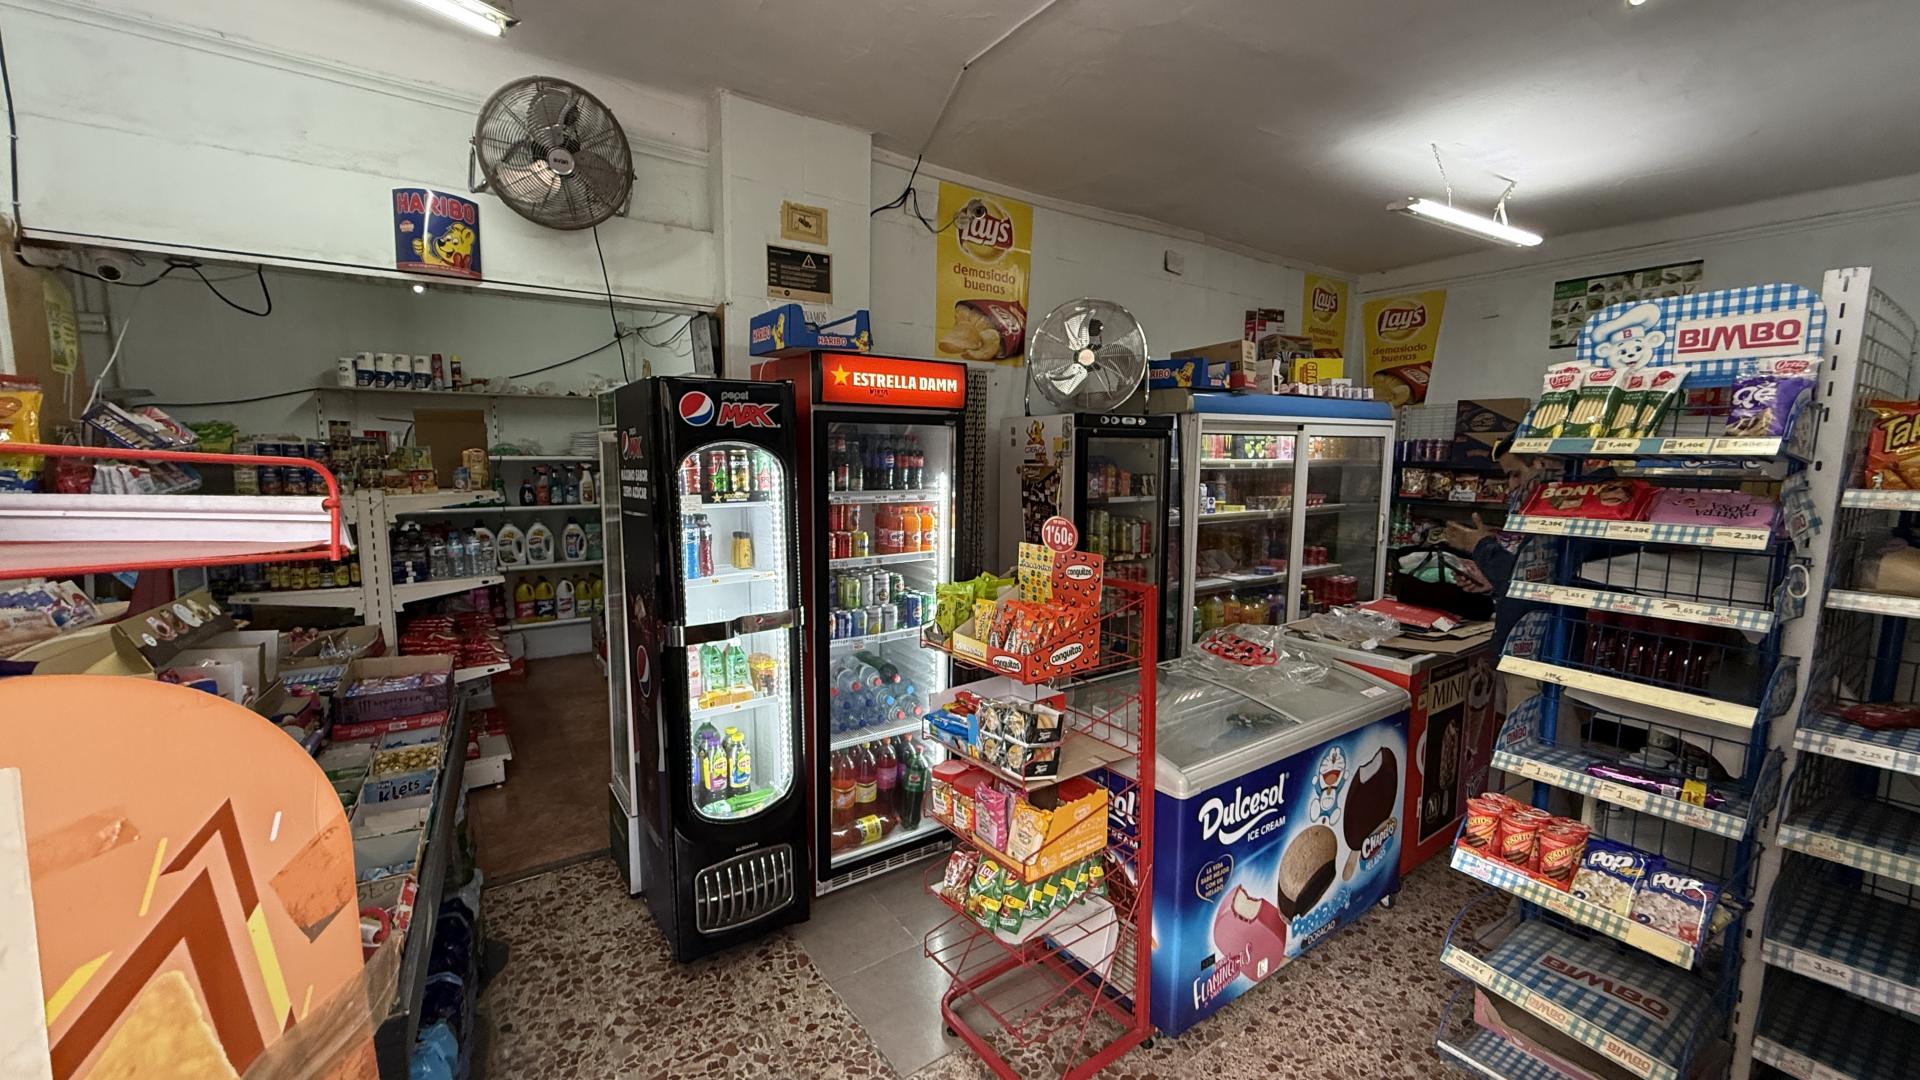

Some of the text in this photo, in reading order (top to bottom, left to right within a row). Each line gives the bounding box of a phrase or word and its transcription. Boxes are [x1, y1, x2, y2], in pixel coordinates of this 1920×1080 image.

[396, 191, 476, 226] HARIBO
[953, 262, 1016, 285] demasiado
[964, 278, 1006, 295] buenas
[1378, 302, 1424, 334] Lay's
[817, 335, 848, 347] HARIBO
[1677, 319, 1802, 352] BIMBO
[1371, 343, 1428, 356] demasiado
[1381, 352, 1417, 362] buenas
[852, 371, 958, 393] ESTRELLA DAMM
[720, 391, 749, 402] pepsi
[716, 402, 780, 429] MAX
[1540, 484, 1604, 499] BONY
[1733, 531, 1765, 541] 2,39€
[1066, 568, 1092, 578] conguitos
[1051, 644, 1082, 663] conguitos
[1432, 674, 1465, 709] MINI
[1198, 772, 1285, 841] Dulcesol
[1247, 816, 1286, 842] ICE CREAM
[1200, 866, 1230, 885] SABE MEJOR
[1206, 862, 1224, 874] LA VIDA
[1204, 884, 1224, 898] HELADO
[1205, 879, 1217, 890] CON
[1539, 954, 1671, 1018] BIMBO
[1528, 996, 1567, 1023] BIMBO
[1606, 1041, 1651, 1074] BIMBO
